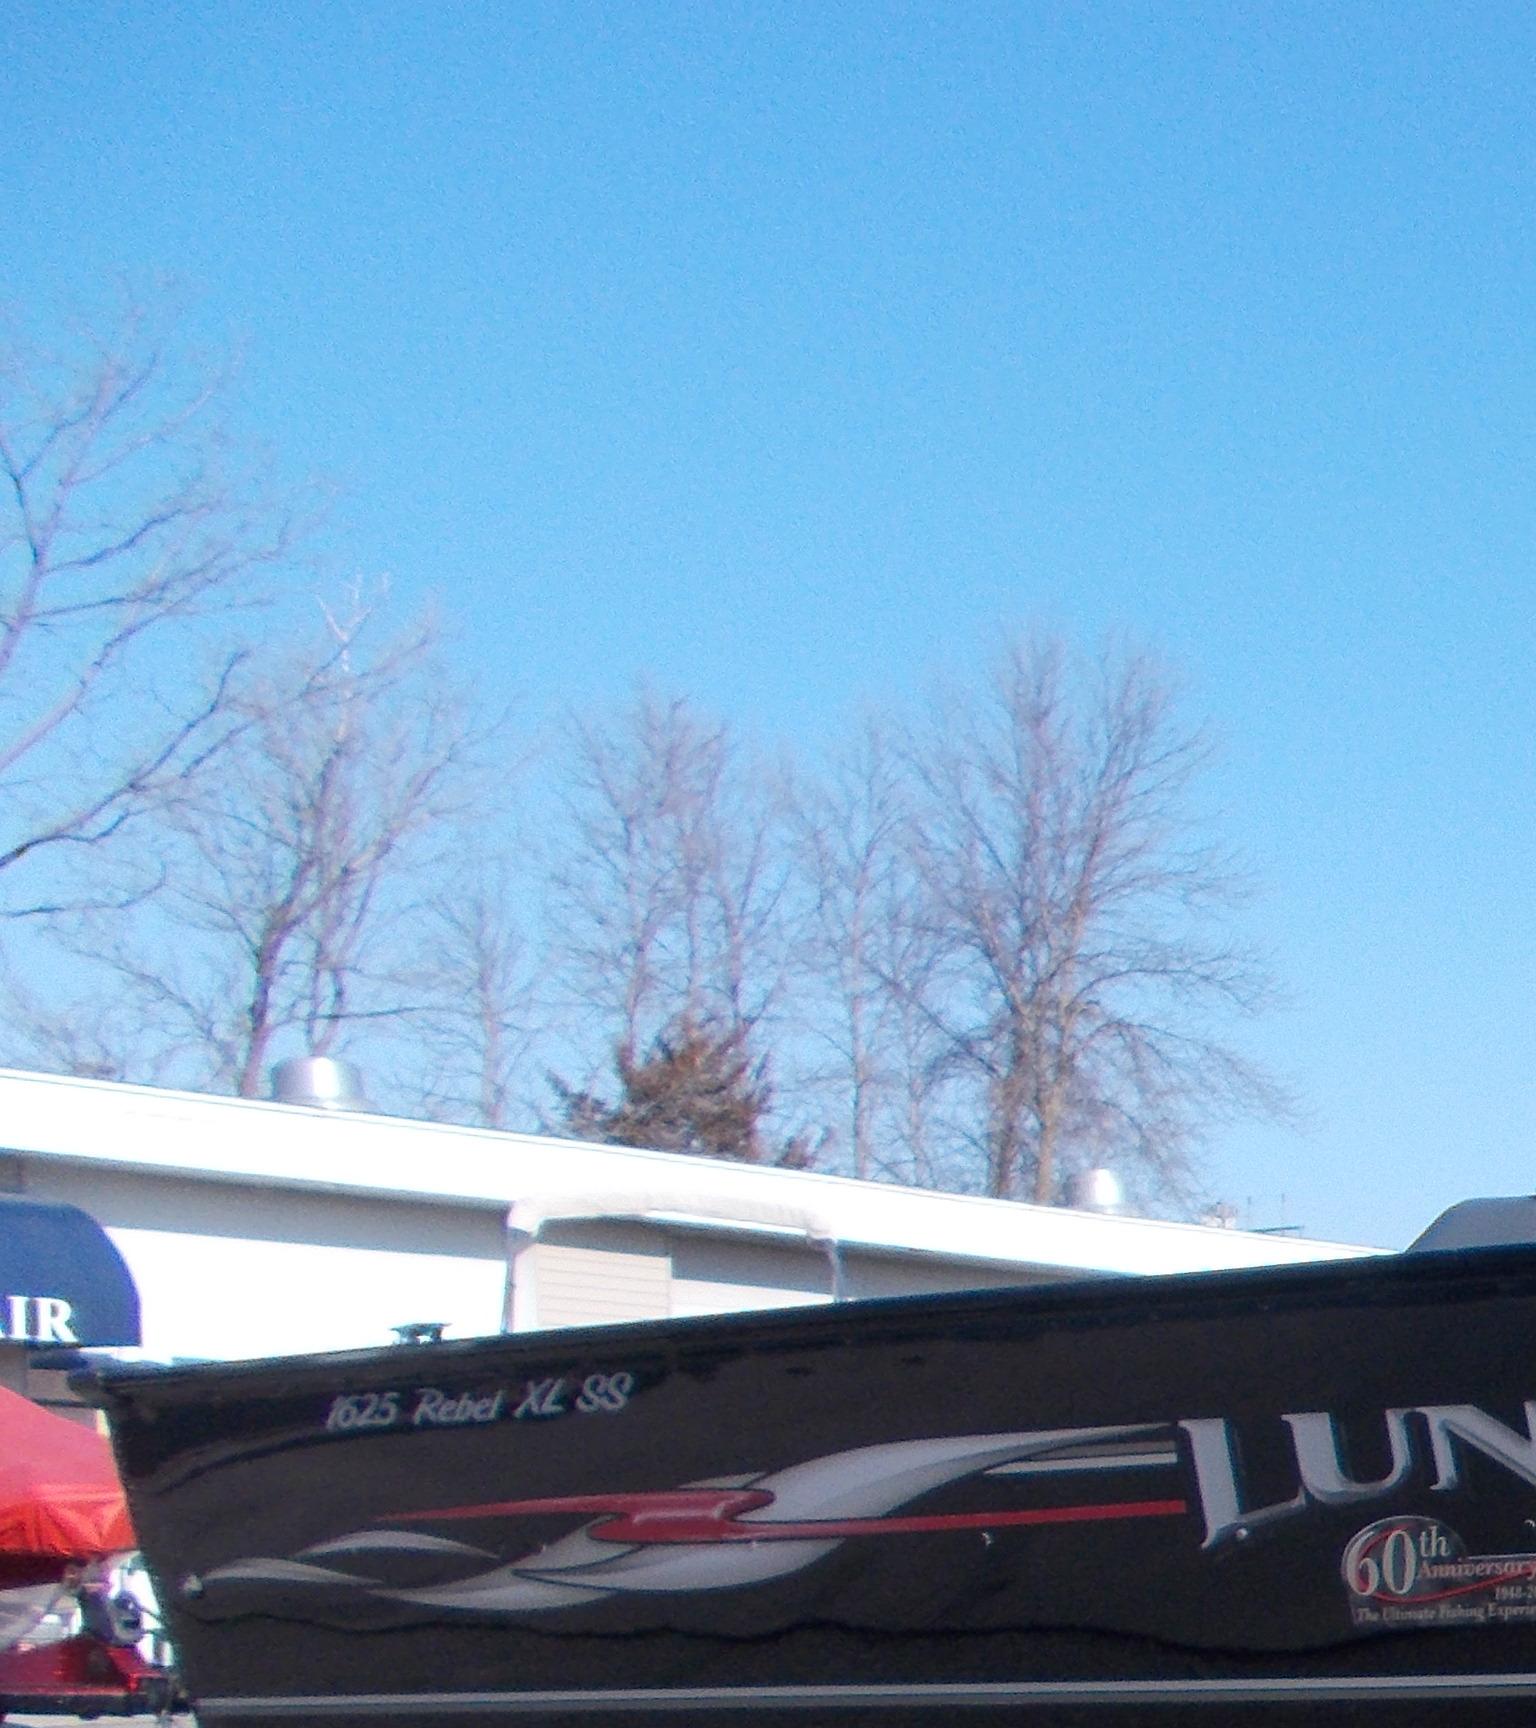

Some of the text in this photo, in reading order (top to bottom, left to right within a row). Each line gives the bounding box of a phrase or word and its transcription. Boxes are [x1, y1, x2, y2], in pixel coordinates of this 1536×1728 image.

[0, 1295, 79, 1342] IR
[327, 1392, 400, 1431] 1625
[514, 1378, 567, 1419] XL
